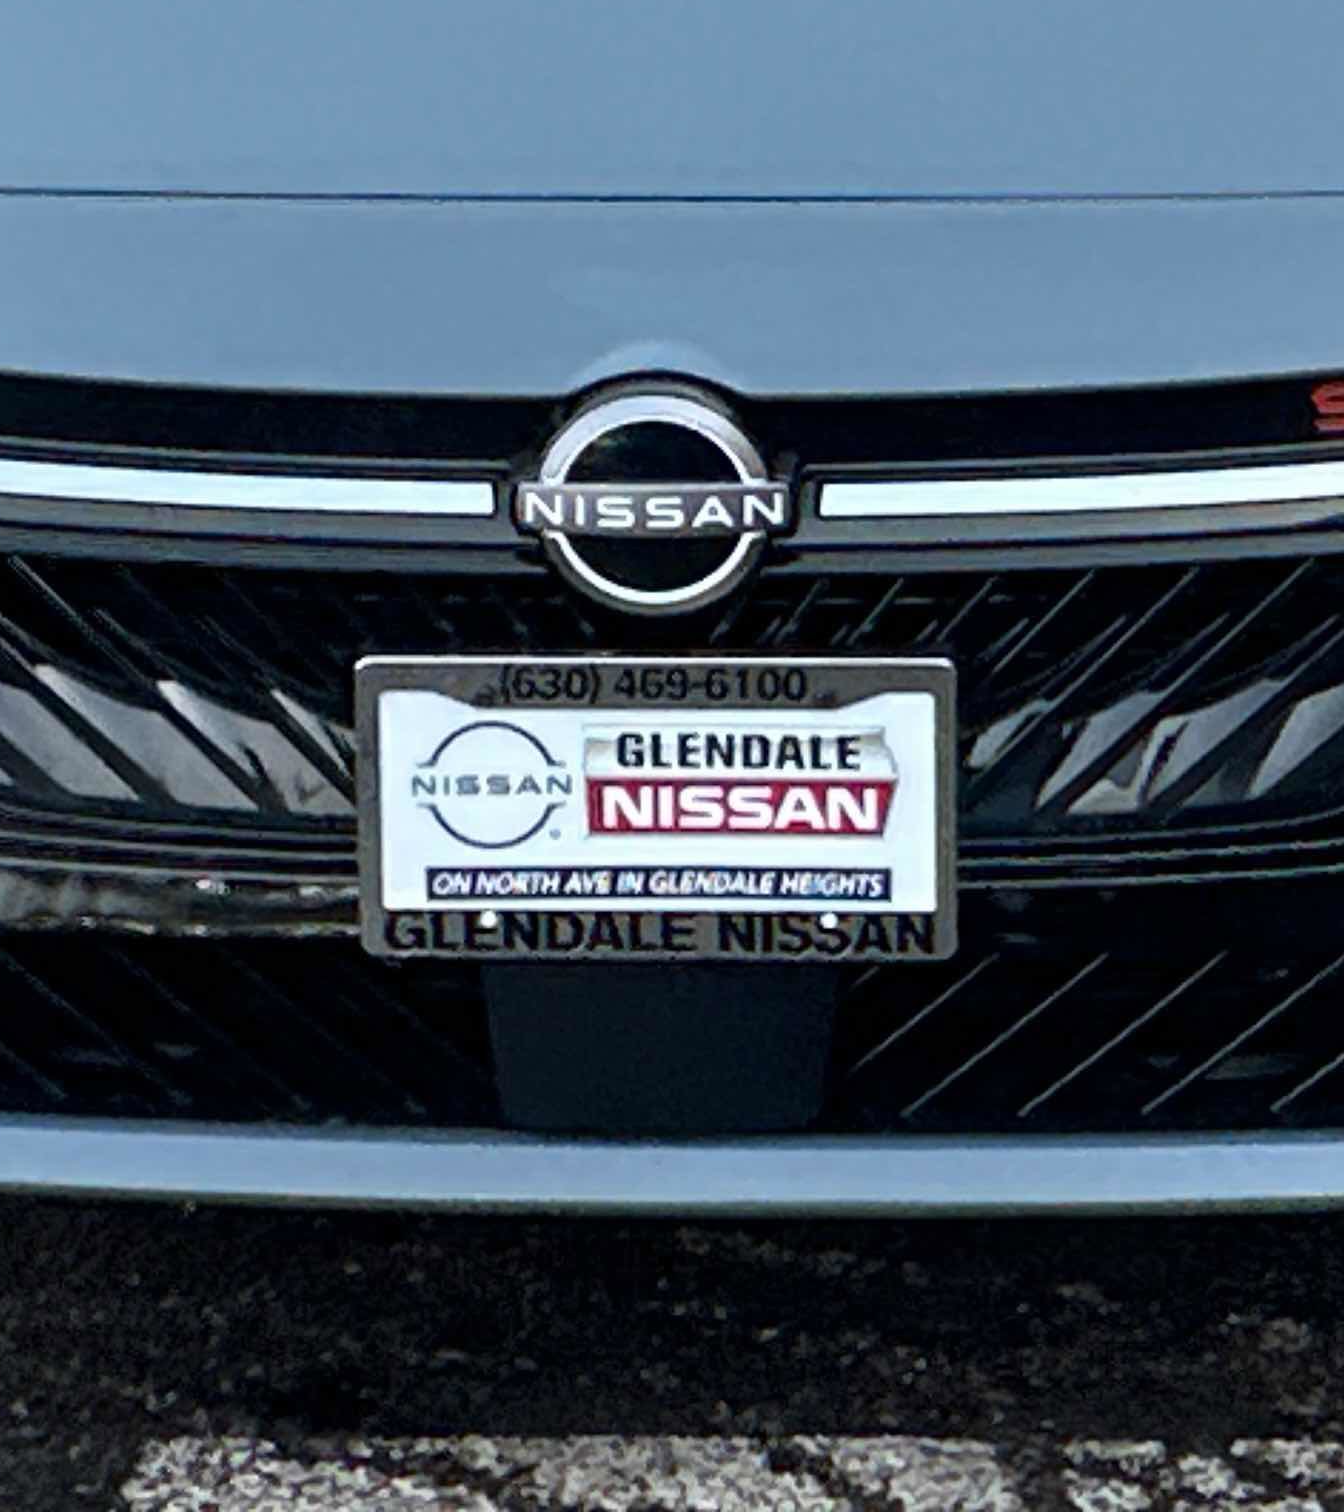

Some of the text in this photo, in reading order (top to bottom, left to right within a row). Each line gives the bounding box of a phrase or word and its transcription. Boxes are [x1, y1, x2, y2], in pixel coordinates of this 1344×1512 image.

[524, 491, 784, 528] NISSAN
[499, 664, 808, 703] (630) 469-6100
[616, 732, 862, 770] GLENDALE
[410, 773, 573, 797] NISSAN
[602, 786, 879, 830] NISSAN
[432, 871, 884, 897] ON NORTH AVE IN GLENDALE HEIGHTS
[384, 909, 936, 953] GLENDALE NISSAN
